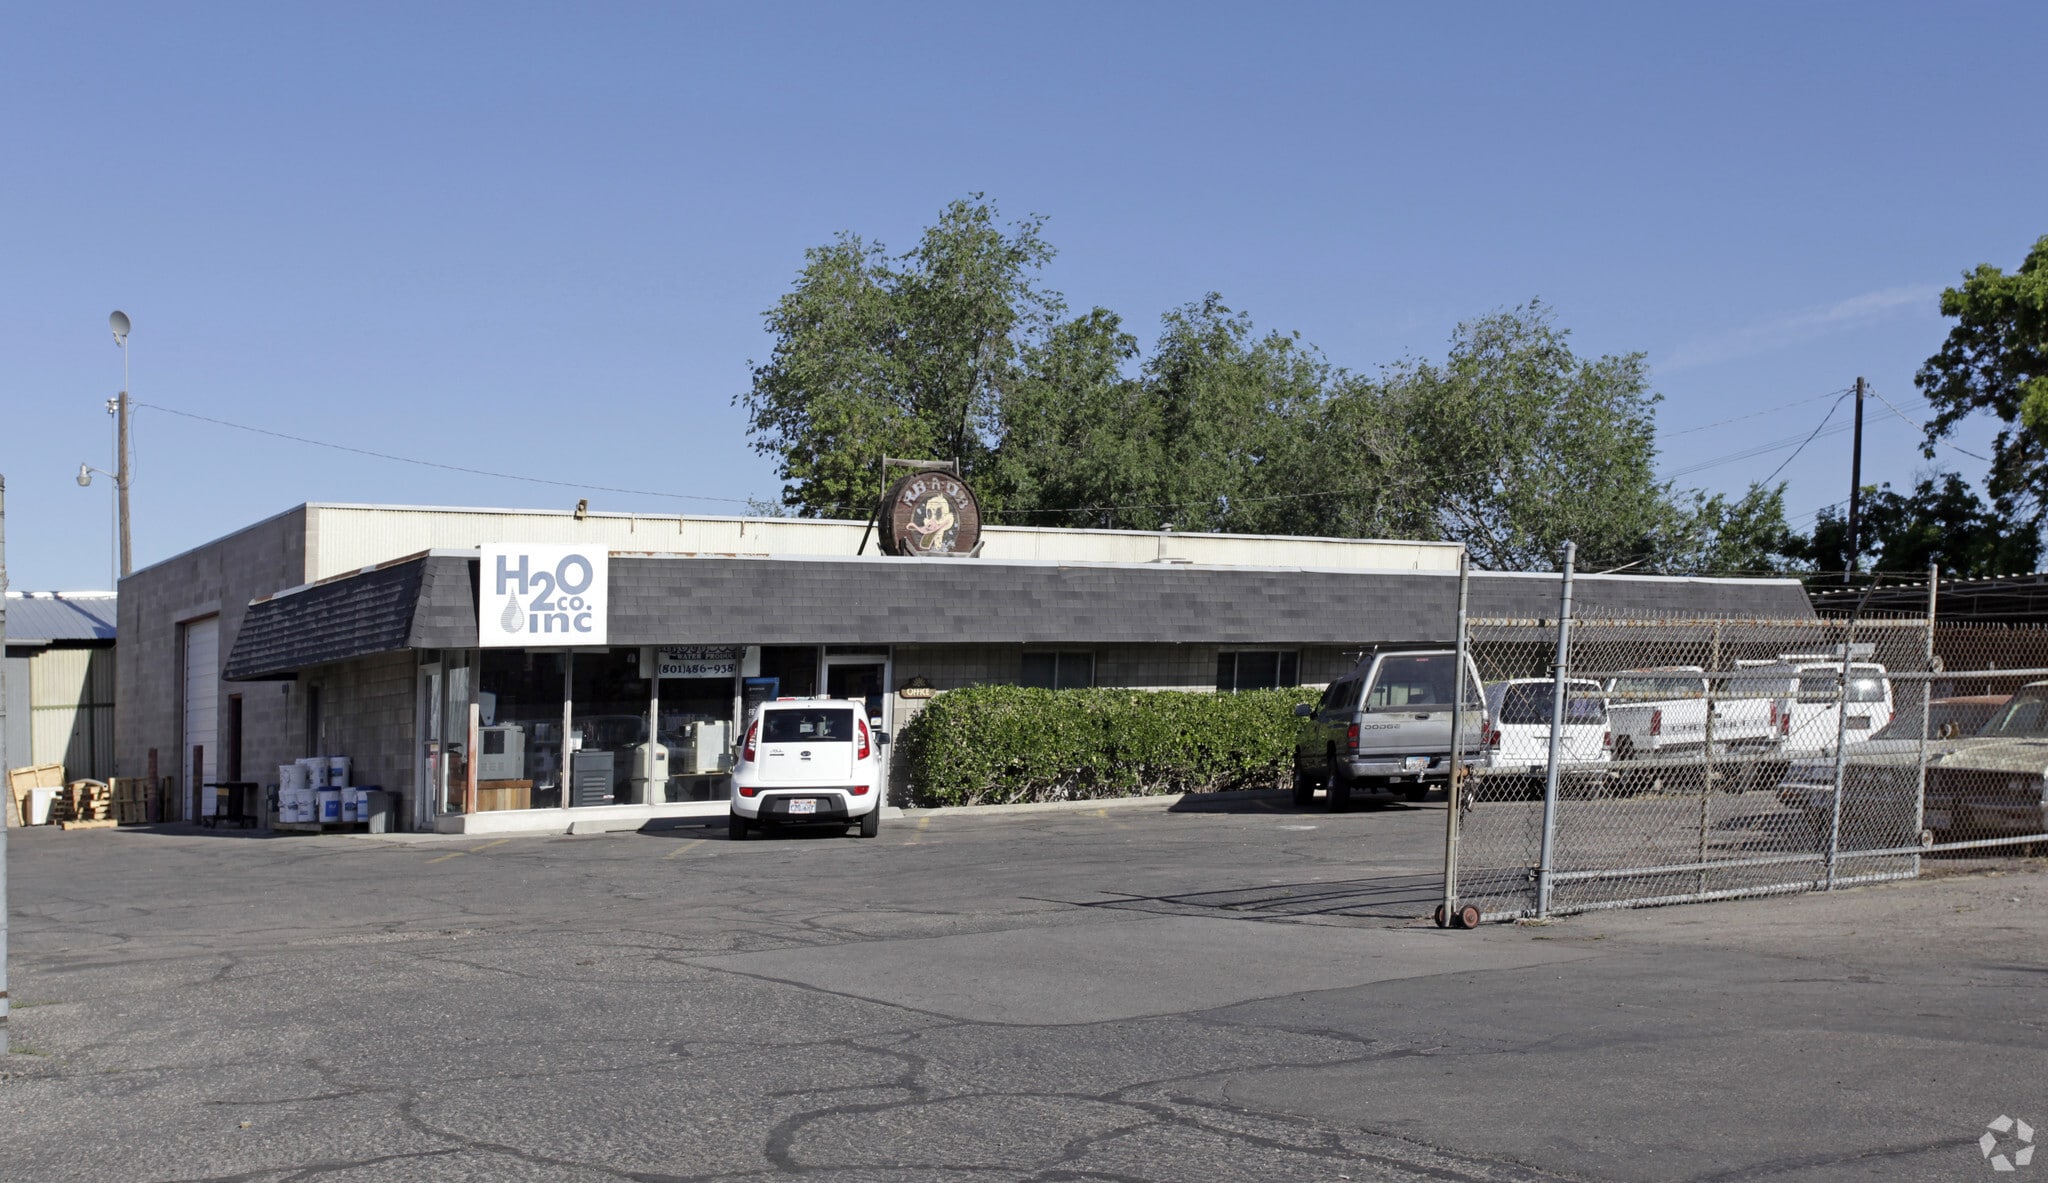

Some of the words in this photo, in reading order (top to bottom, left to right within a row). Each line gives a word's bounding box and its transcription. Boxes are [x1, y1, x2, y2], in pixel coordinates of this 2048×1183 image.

[496, 554, 594, 611] H2O
[658, 664, 737, 674] (801)486-938
[906, 688, 930, 696] OFFICE
